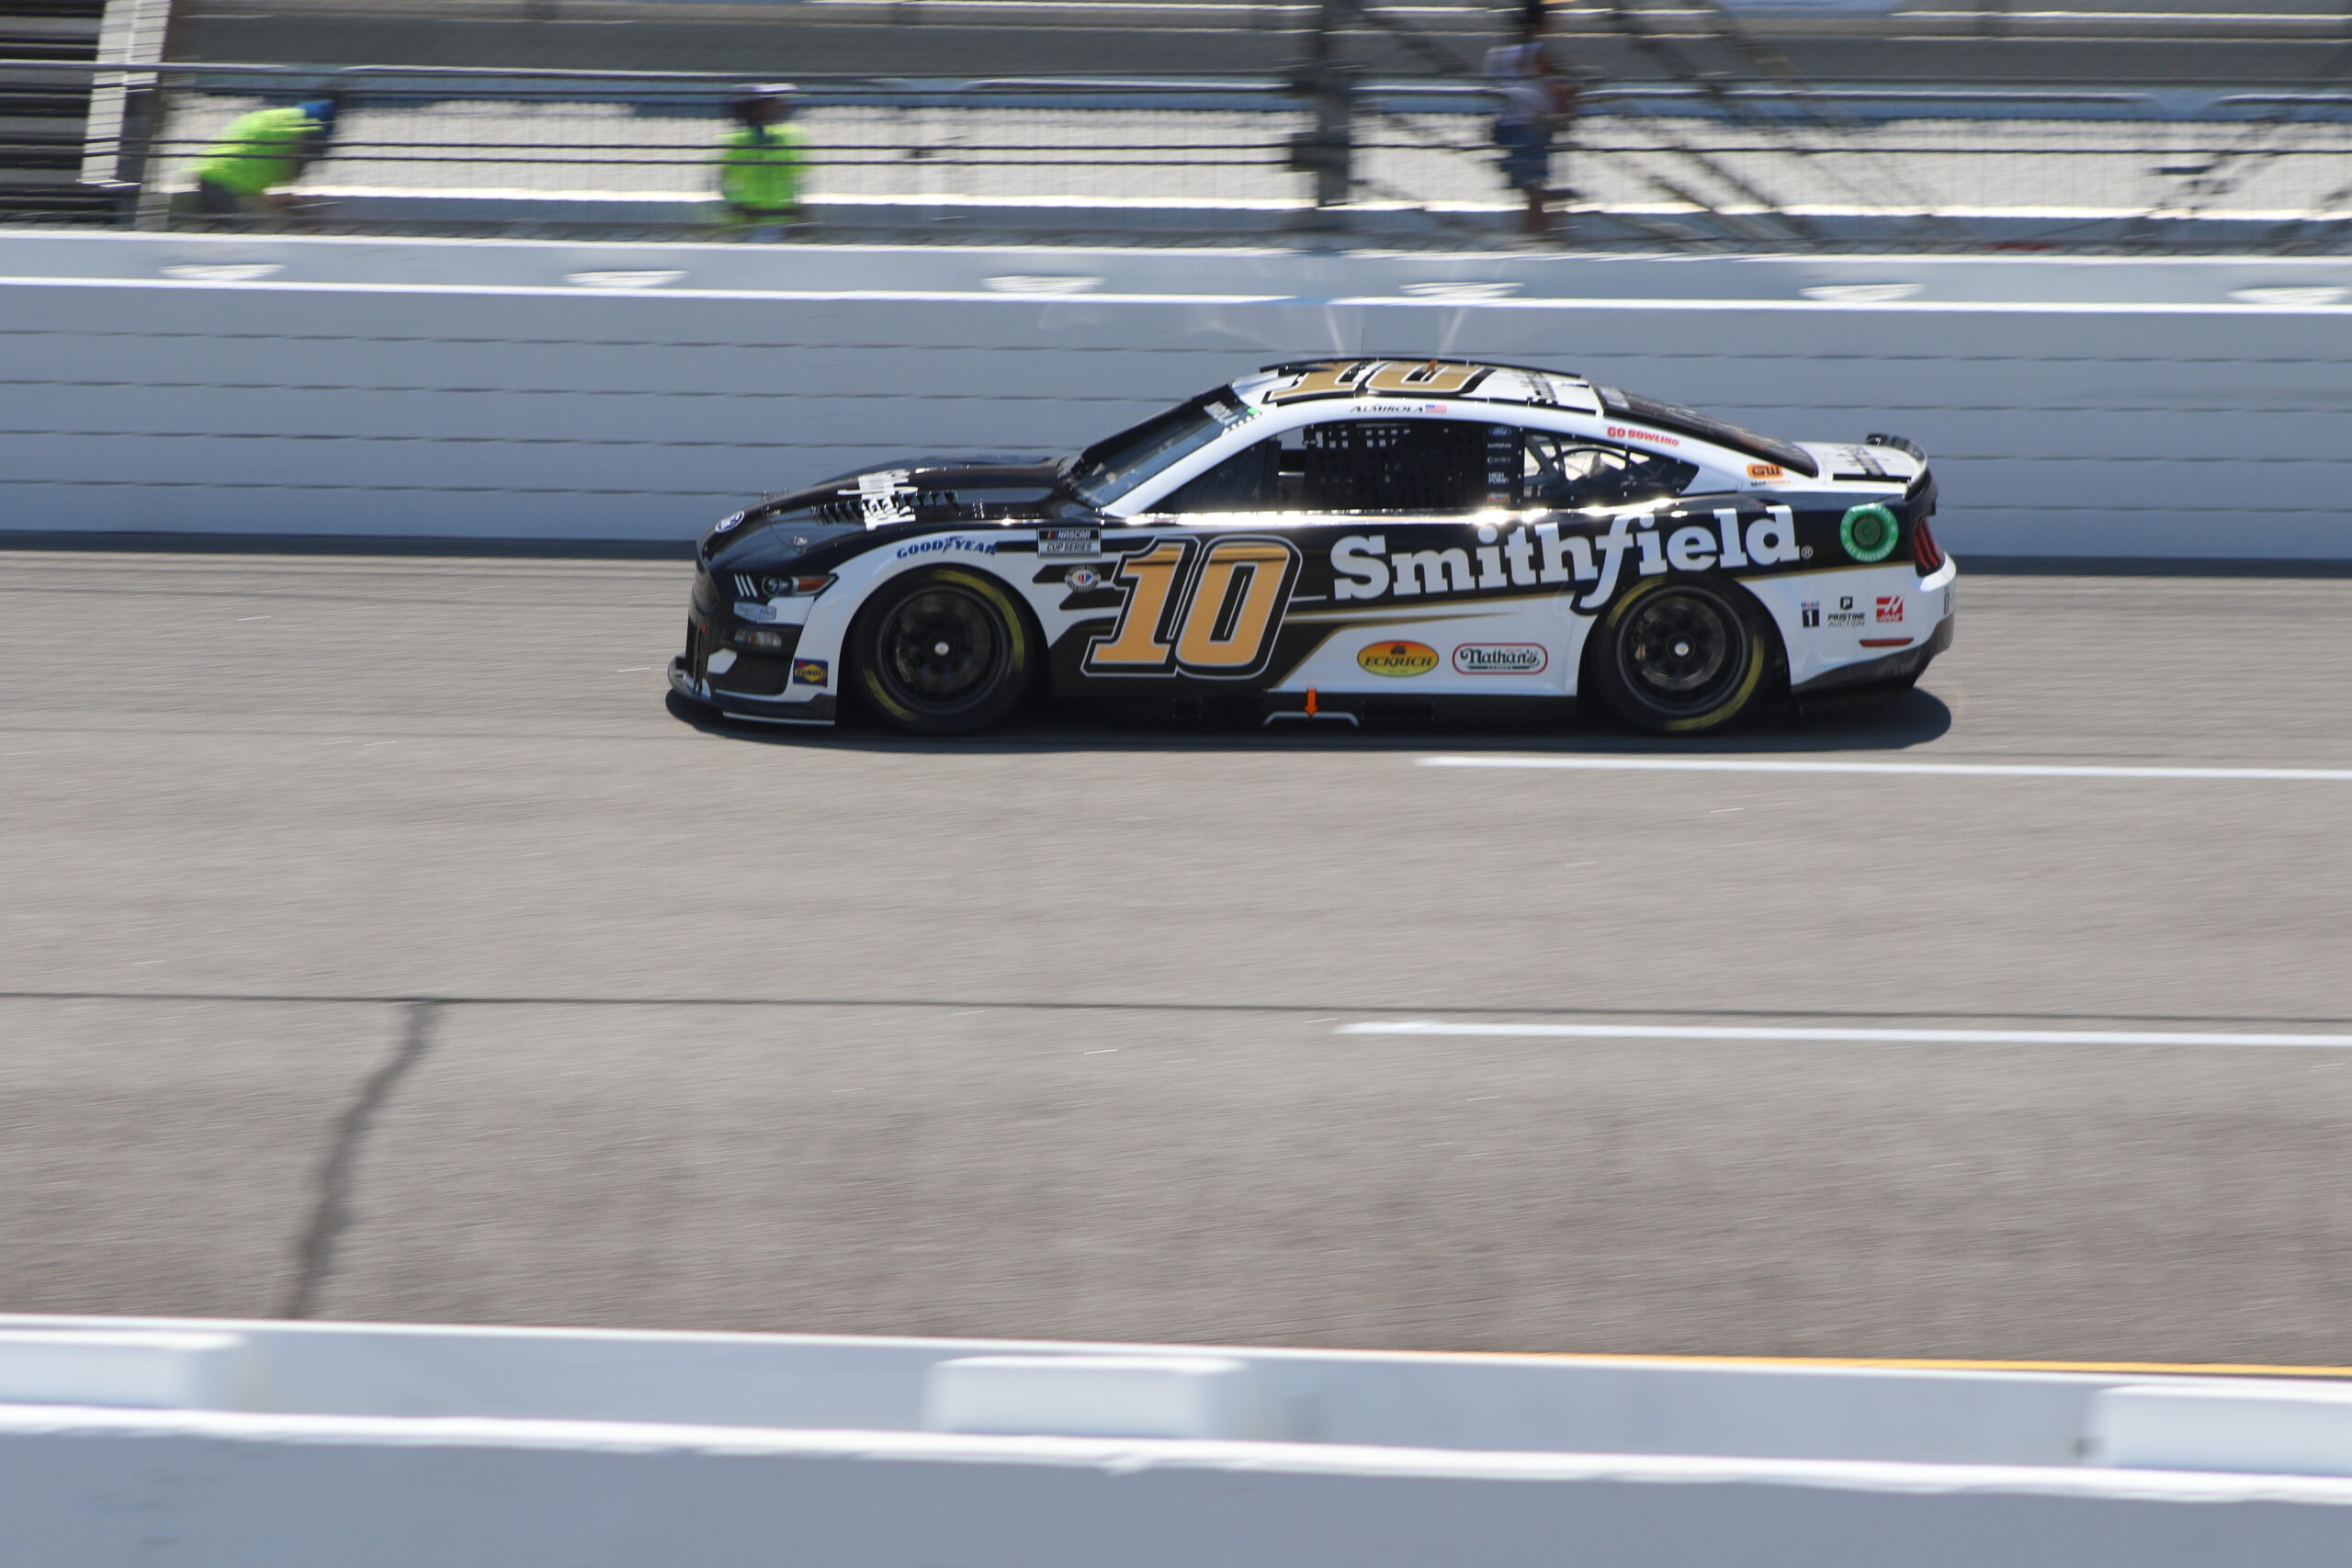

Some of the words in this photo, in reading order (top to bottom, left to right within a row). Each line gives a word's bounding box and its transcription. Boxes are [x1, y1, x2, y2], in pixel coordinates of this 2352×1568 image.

[1264, 360, 1490, 404] 10
[1608, 426, 1625, 438] GO
[1628, 429, 1679, 446] BOWLING
[1058, 530, 1091, 540] NASCAR
[897, 536, 996, 558] GOODYEAR
[1047, 543, 1064, 552] CUP
[1064, 543, 1092, 552] SERIES
[1330, 505, 1800, 610] Smithfield
[1087, 540, 1291, 671] 10
[1801, 602, 1820, 610] Mobil
[1828, 613, 1866, 621] PRISTINE
[1364, 656, 1432, 668] ECKRICH
[1460, 648, 1540, 667] Nathan's
